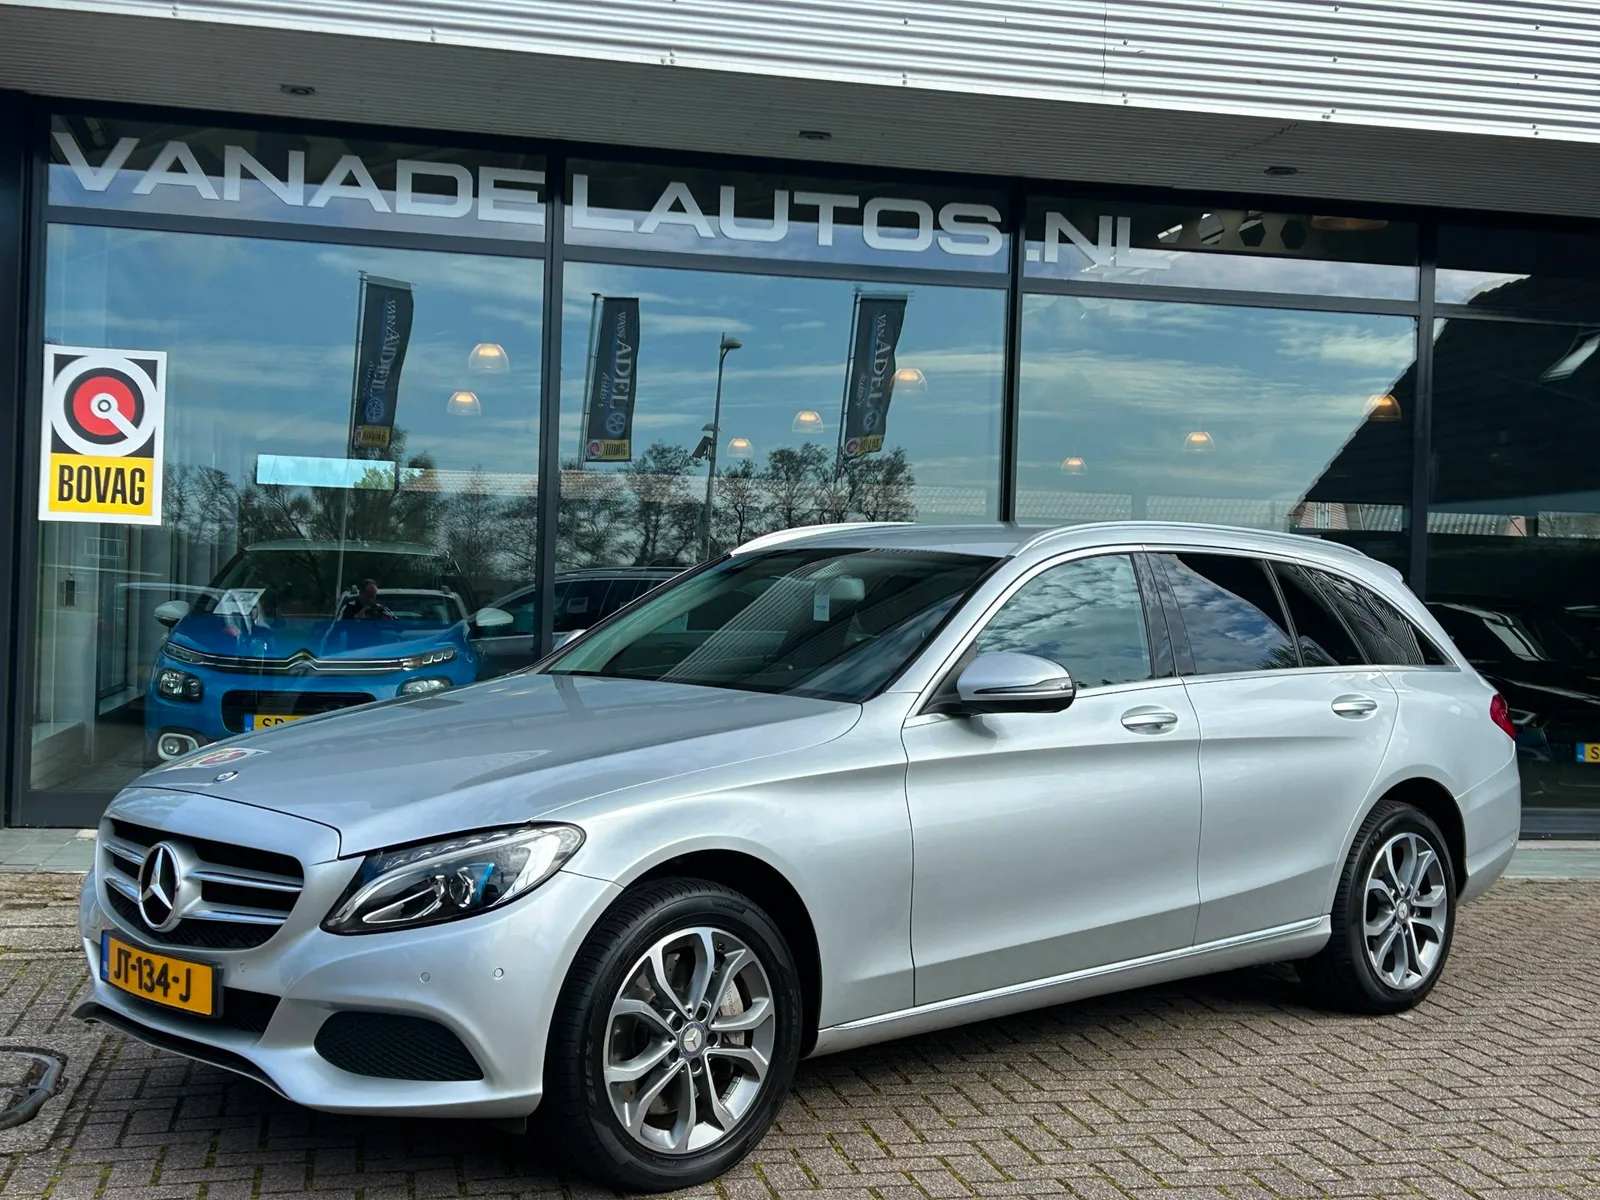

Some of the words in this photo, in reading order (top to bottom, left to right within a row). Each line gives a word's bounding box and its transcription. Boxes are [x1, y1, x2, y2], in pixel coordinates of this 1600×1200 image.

[610, 339, 632, 409] ADEL
[866, 339, 891, 409] ADEL
[58, 465, 145, 505] BOVAG
[113, 947, 192, 1003] JT-134-J
